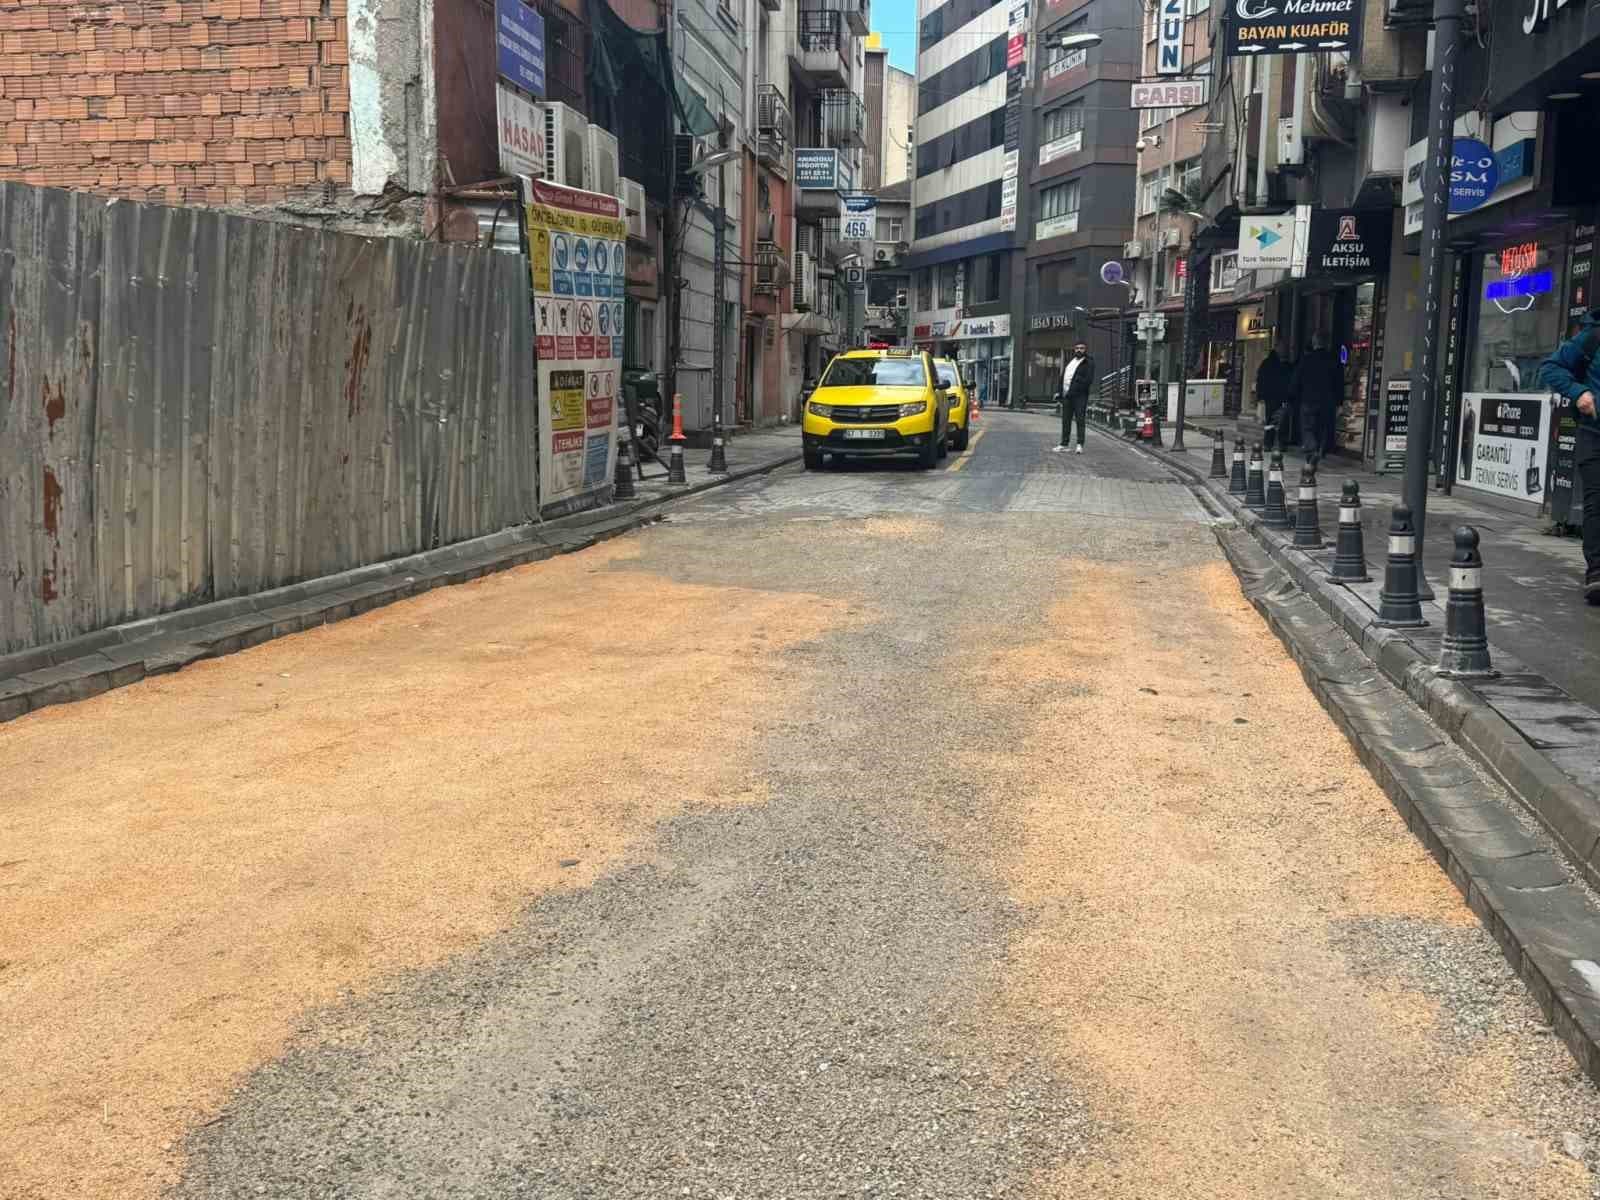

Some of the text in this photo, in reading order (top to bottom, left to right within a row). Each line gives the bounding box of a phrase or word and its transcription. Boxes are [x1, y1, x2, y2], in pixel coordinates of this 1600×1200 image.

[1238, 21, 1350, 40] BAYAN KUAFÖR
[845, 222, 865, 236] 469
[1331, 243, 1364, 253] AKSU
[1322, 254, 1370, 269] İLETİŞİM
